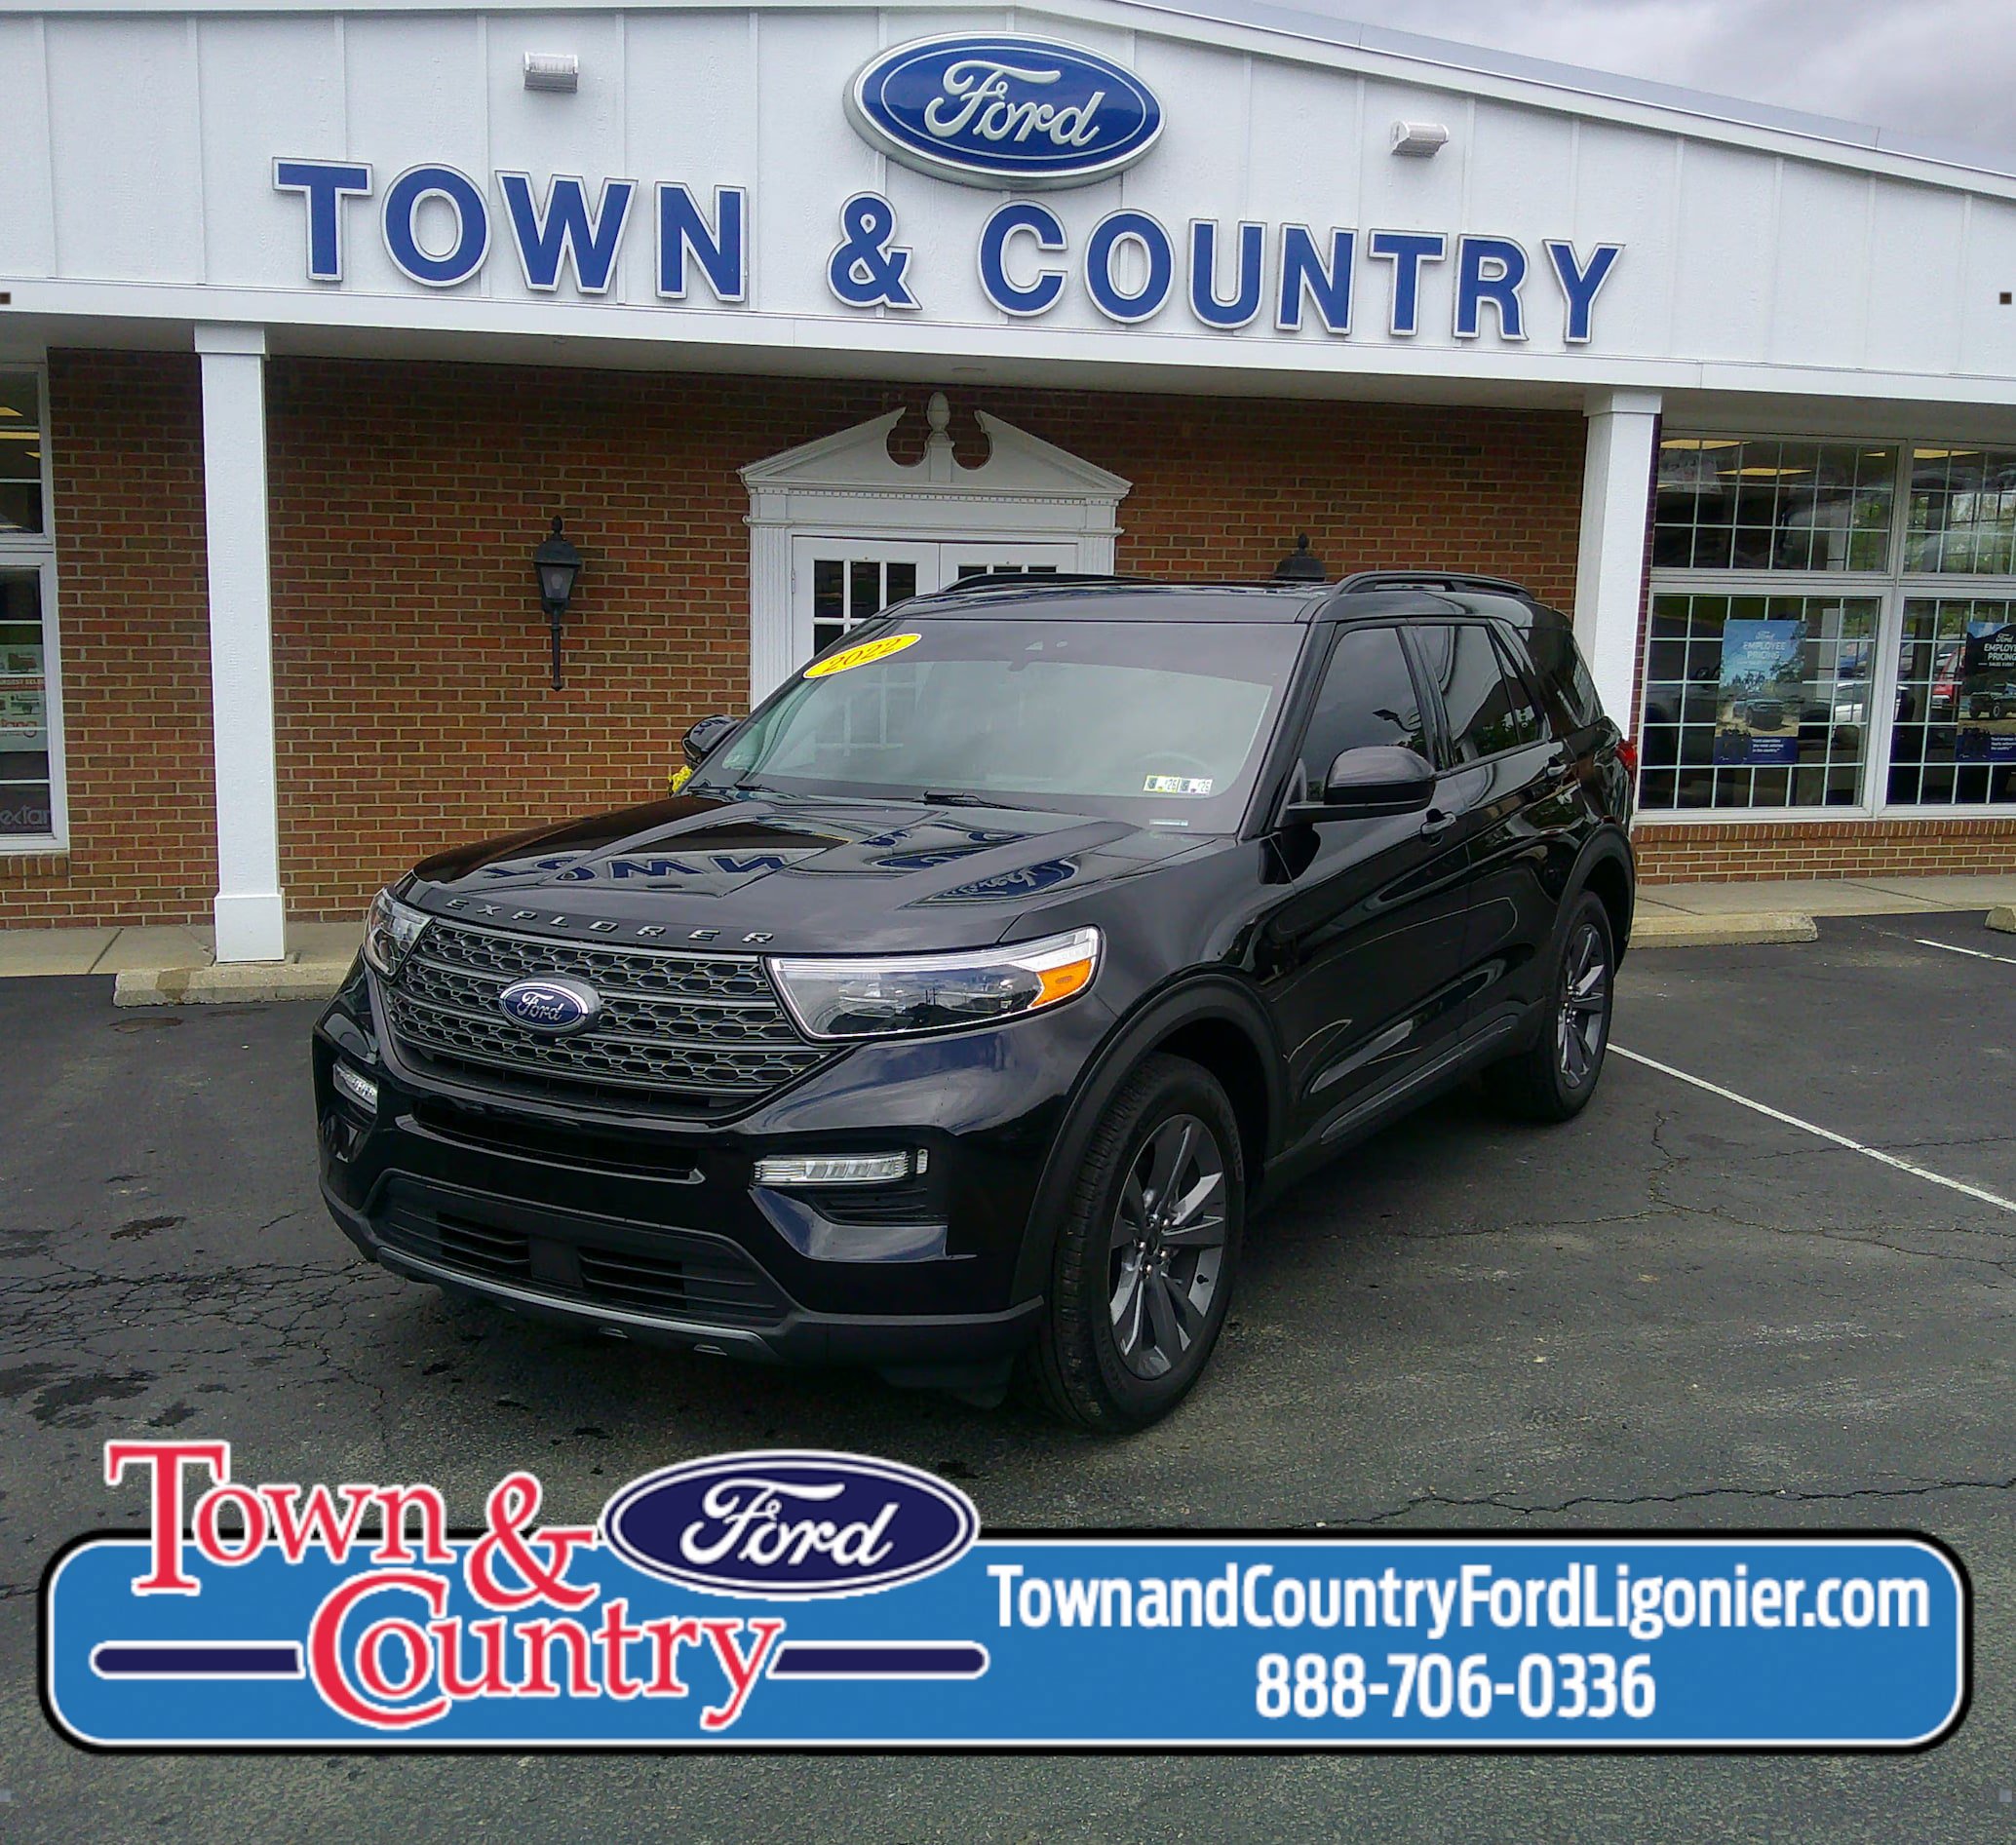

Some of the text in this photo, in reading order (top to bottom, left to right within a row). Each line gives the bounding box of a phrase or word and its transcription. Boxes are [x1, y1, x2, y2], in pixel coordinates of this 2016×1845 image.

[923, 59, 1105, 148] Ford
[272, 157, 1626, 344] TOWN & COUNTRY
[822, 638, 902, 673] 2022
[445, 898, 774, 944] EXPLORER
[517, 991, 562, 1022] Ford
